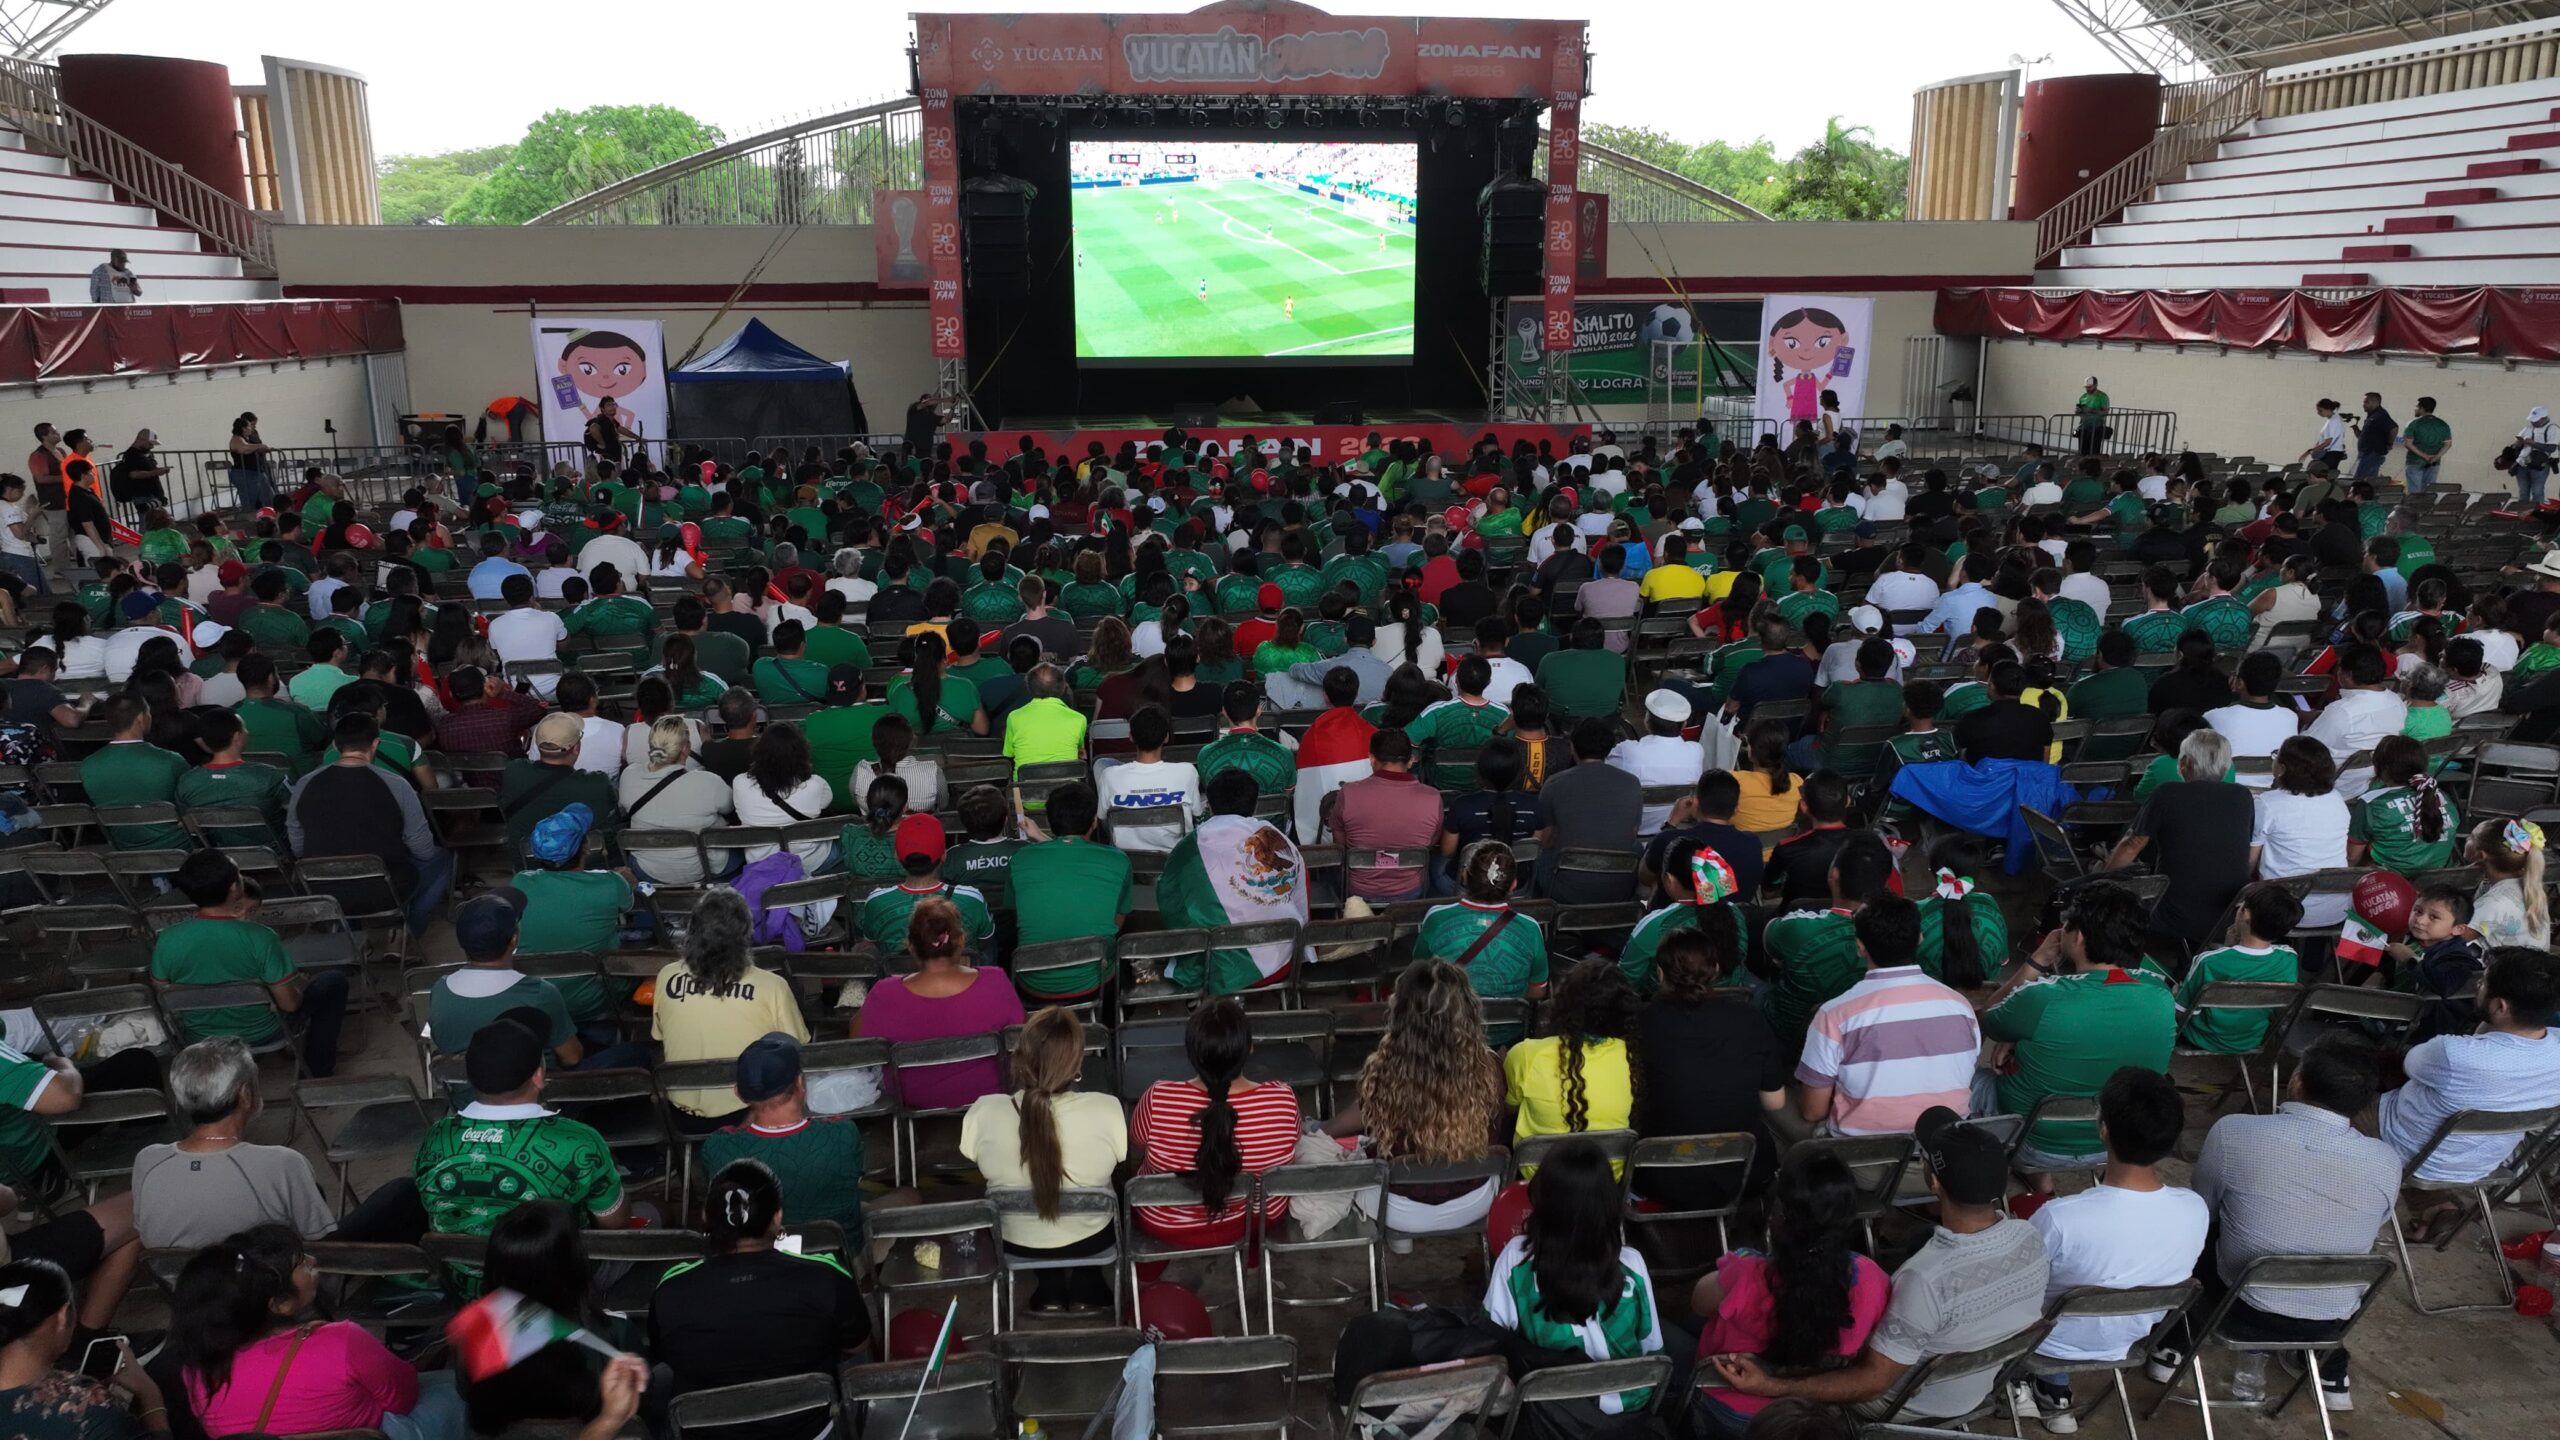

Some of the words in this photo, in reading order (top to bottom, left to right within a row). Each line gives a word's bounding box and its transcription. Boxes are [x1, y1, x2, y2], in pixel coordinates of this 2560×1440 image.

[1012, 44, 1104, 61] YUCATÁN
[1129, 36, 1256, 75] YUCATÁN
[1417, 44, 1542, 59] ZONAFAN
[1452, 65, 1505, 78] 2026
[924, 88, 948, 98] ZONA
[1556, 91, 1577, 100] ZONA
[927, 100, 947, 109] FAN
[1556, 101, 1576, 110] FAN
[930, 185, 953, 196] ZONA
[1551, 184, 1573, 194] ZONA
[932, 196, 952, 206] FAN
[1552, 194, 1571, 204] FAN
[933, 280, 957, 290] ZONA
[1549, 275, 1571, 285] ZONA
[935, 290, 956, 300] FAN
[1550, 285, 1569, 294] FAN
[1608, 331, 1638, 343] 2026
[1135, 438, 1322, 458] ZAFAN
[965, 855, 1012, 871] MÉXIC
[2360, 890, 2399, 909] YUCATÁN
[2368, 898, 2400, 918] JUEGA
[665, 972, 755, 1002] Cona
[461, 1127, 505, 1144] Coca-Cola
